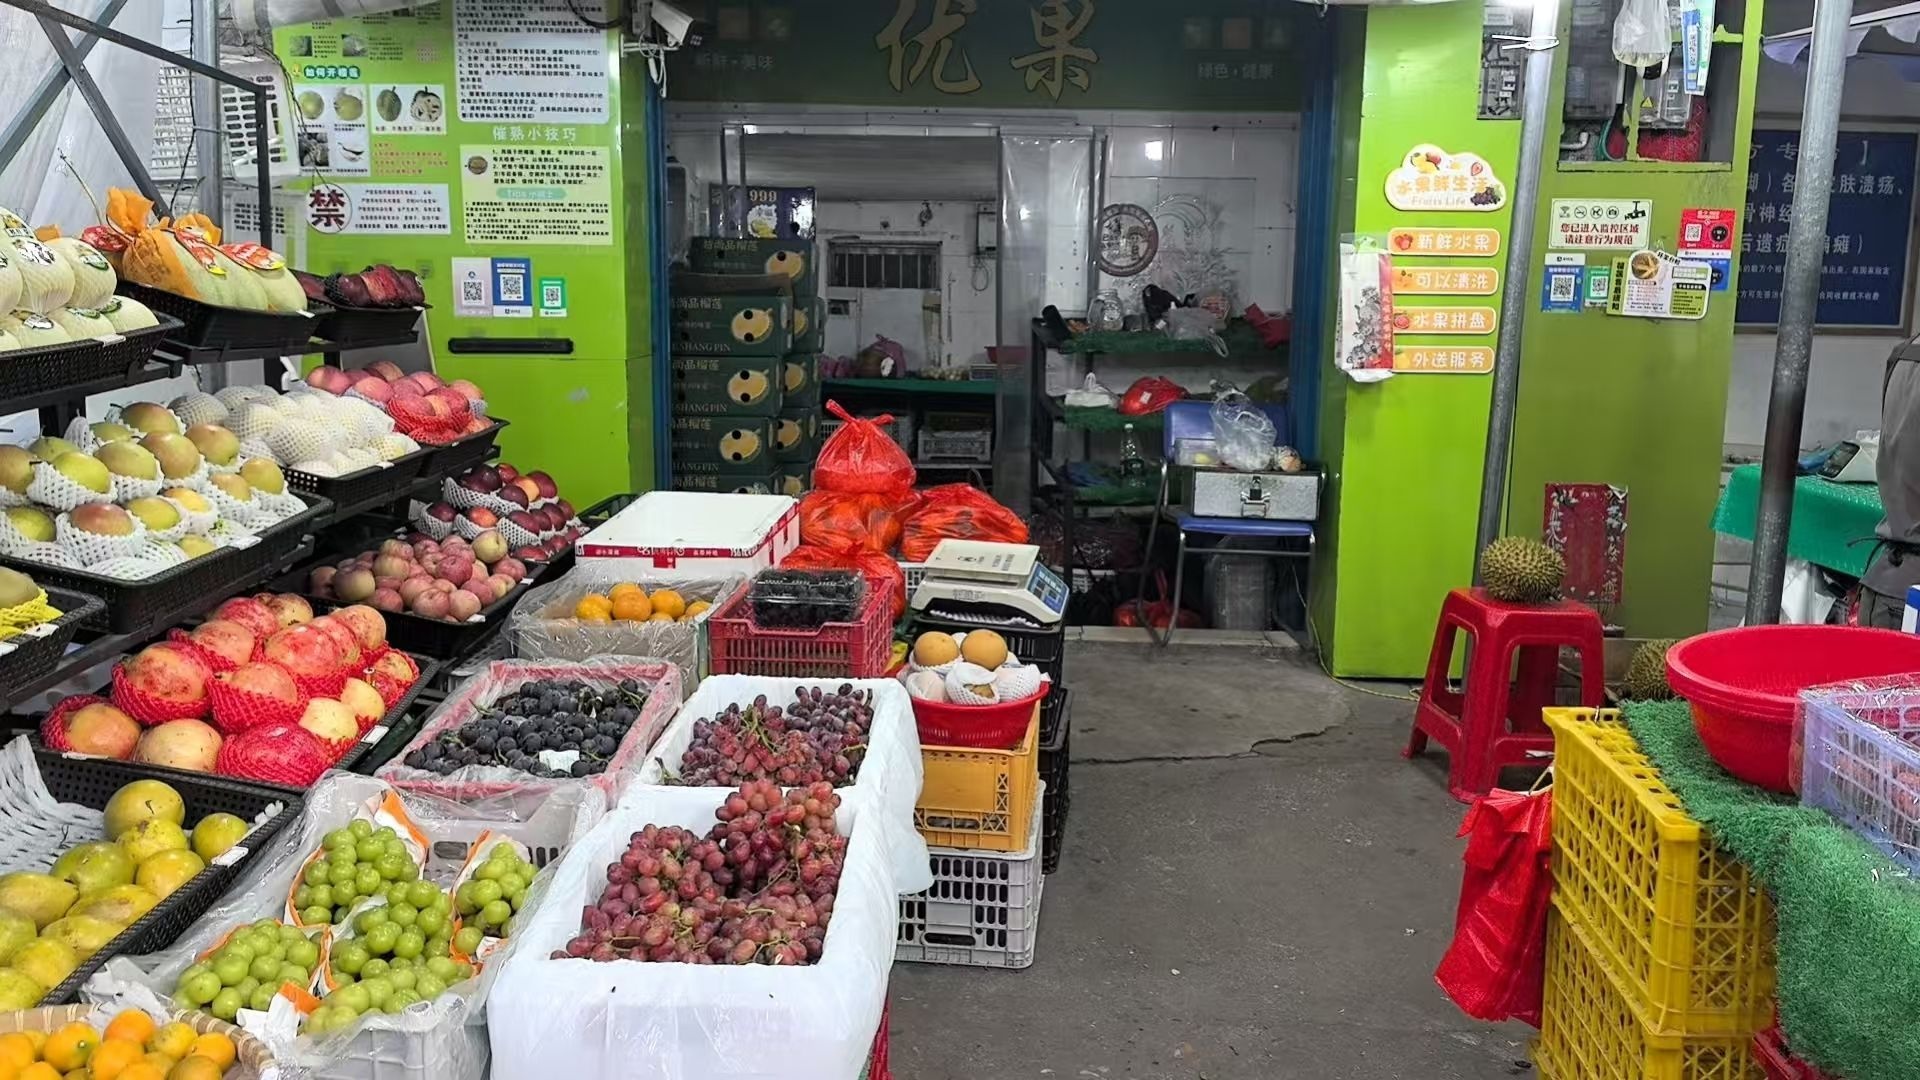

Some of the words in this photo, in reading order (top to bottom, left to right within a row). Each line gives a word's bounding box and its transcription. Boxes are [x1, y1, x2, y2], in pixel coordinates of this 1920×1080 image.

[875, 0, 1099, 100] 优果
[493, 127, 577, 142] 催熟小技巧
[749, 190, 777, 202] 999
[1411, 196, 1442, 206] Fruits
[1446, 196, 1466, 205] Life
[309, 189, 346, 228] 禁
[1560, 222, 1640, 235] 您已进入监控区域
[1417, 234, 1491, 250] 新鲜水果
[1565, 234, 1633, 246] 请注意行为规范
[1416, 274, 1489, 290] 可以清洗
[1414, 313, 1486, 329] 水果拼盘
[714, 343, 731, 352] PIN
[1413, 352, 1486, 369] 外送服务
[710, 403, 728, 412] PIN
